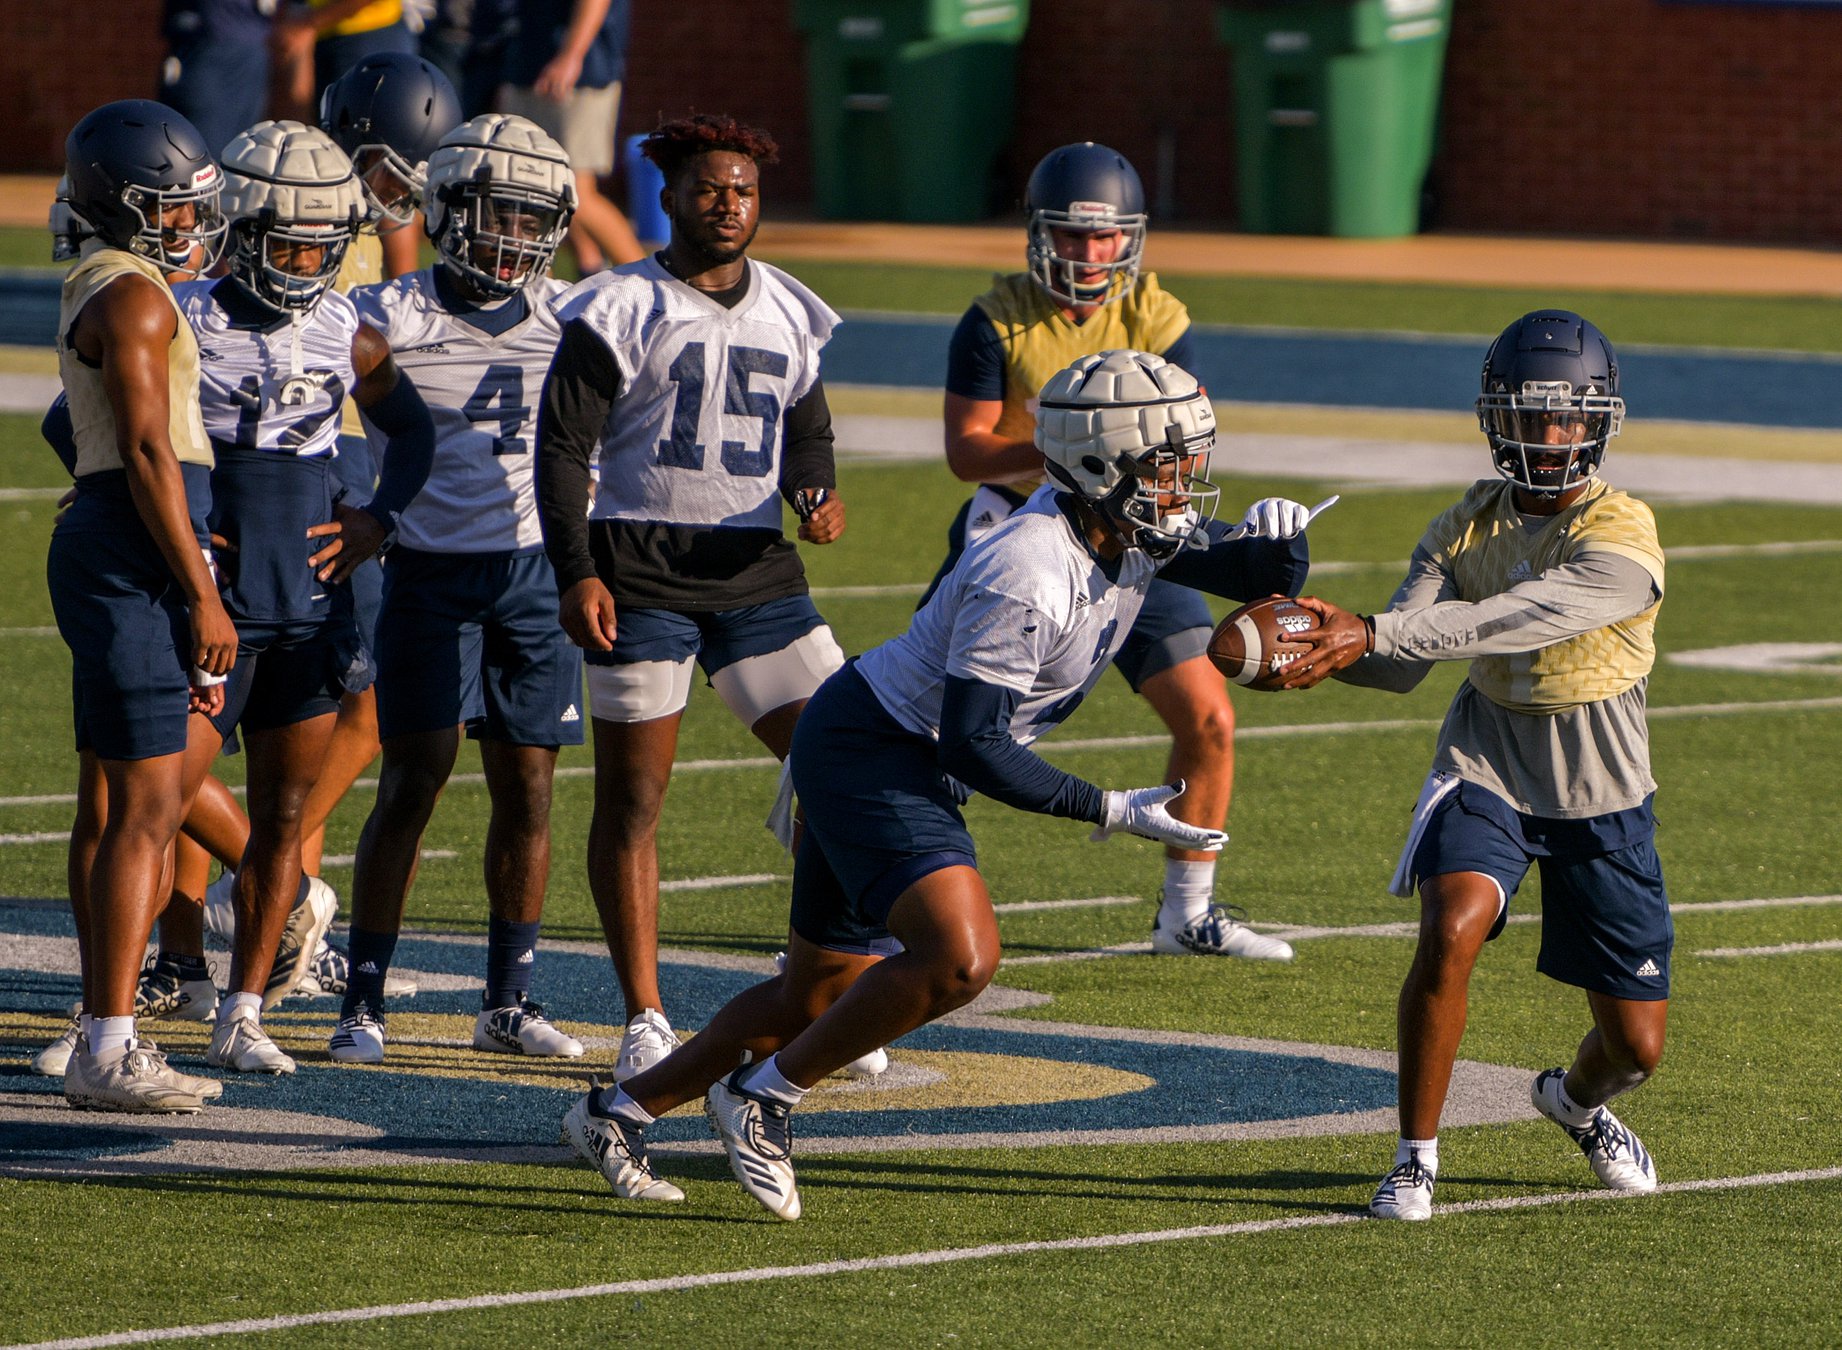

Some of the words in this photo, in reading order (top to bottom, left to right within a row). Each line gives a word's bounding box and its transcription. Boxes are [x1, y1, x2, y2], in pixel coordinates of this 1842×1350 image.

[229, 368, 345, 450] 12
[460, 364, 532, 456] 4
[657, 341, 789, 478] 15
[1276, 615, 1311, 625] adidas
[1636, 968, 1660, 977] adidas
[484, 1022, 524, 1055] adidas
